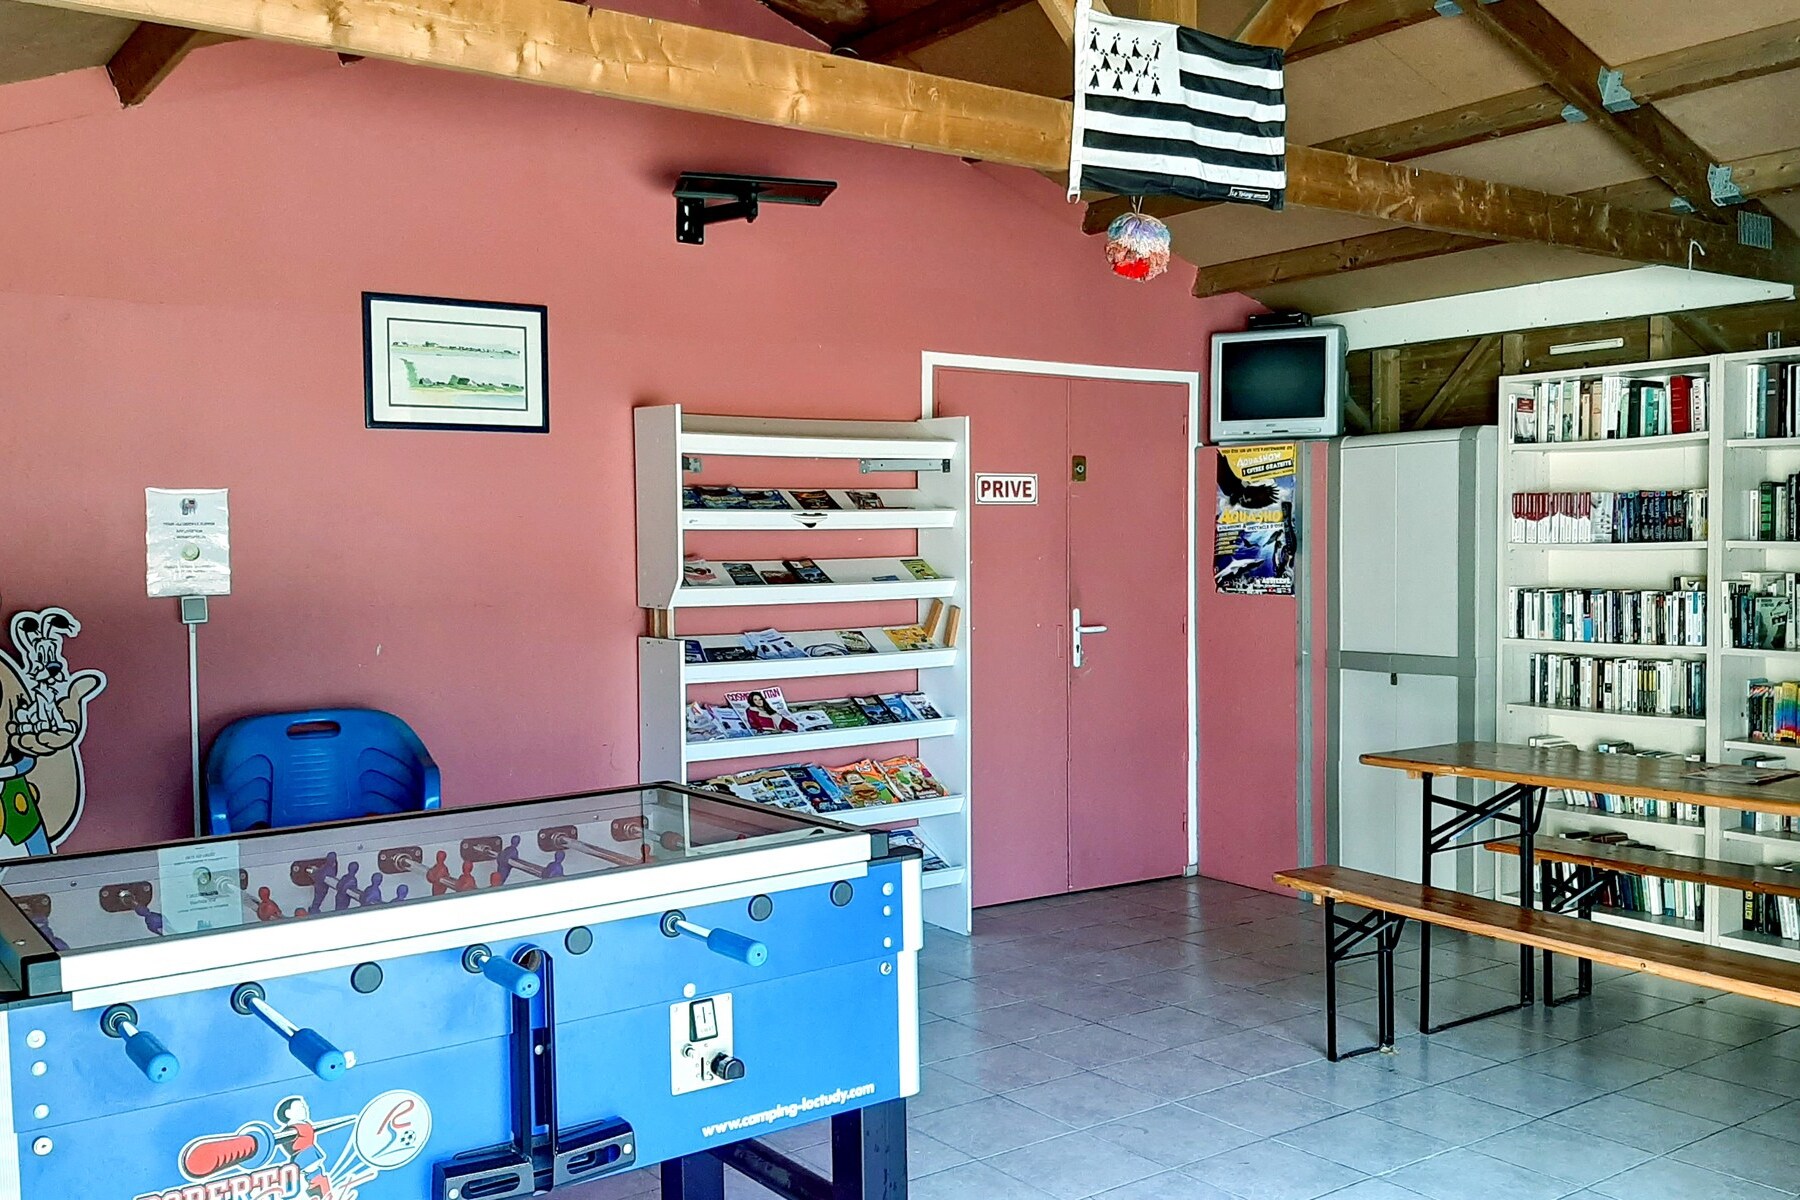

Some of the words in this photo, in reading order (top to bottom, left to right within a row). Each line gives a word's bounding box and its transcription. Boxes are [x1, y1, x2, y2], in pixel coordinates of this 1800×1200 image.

[981, 480, 1032, 498] PRIVE
[727, 688, 781, 701] COSMOITAN
[702, 1083, 875, 1137] www.camping-loctudy.com
[137, 1165, 299, 1200] ERTO
